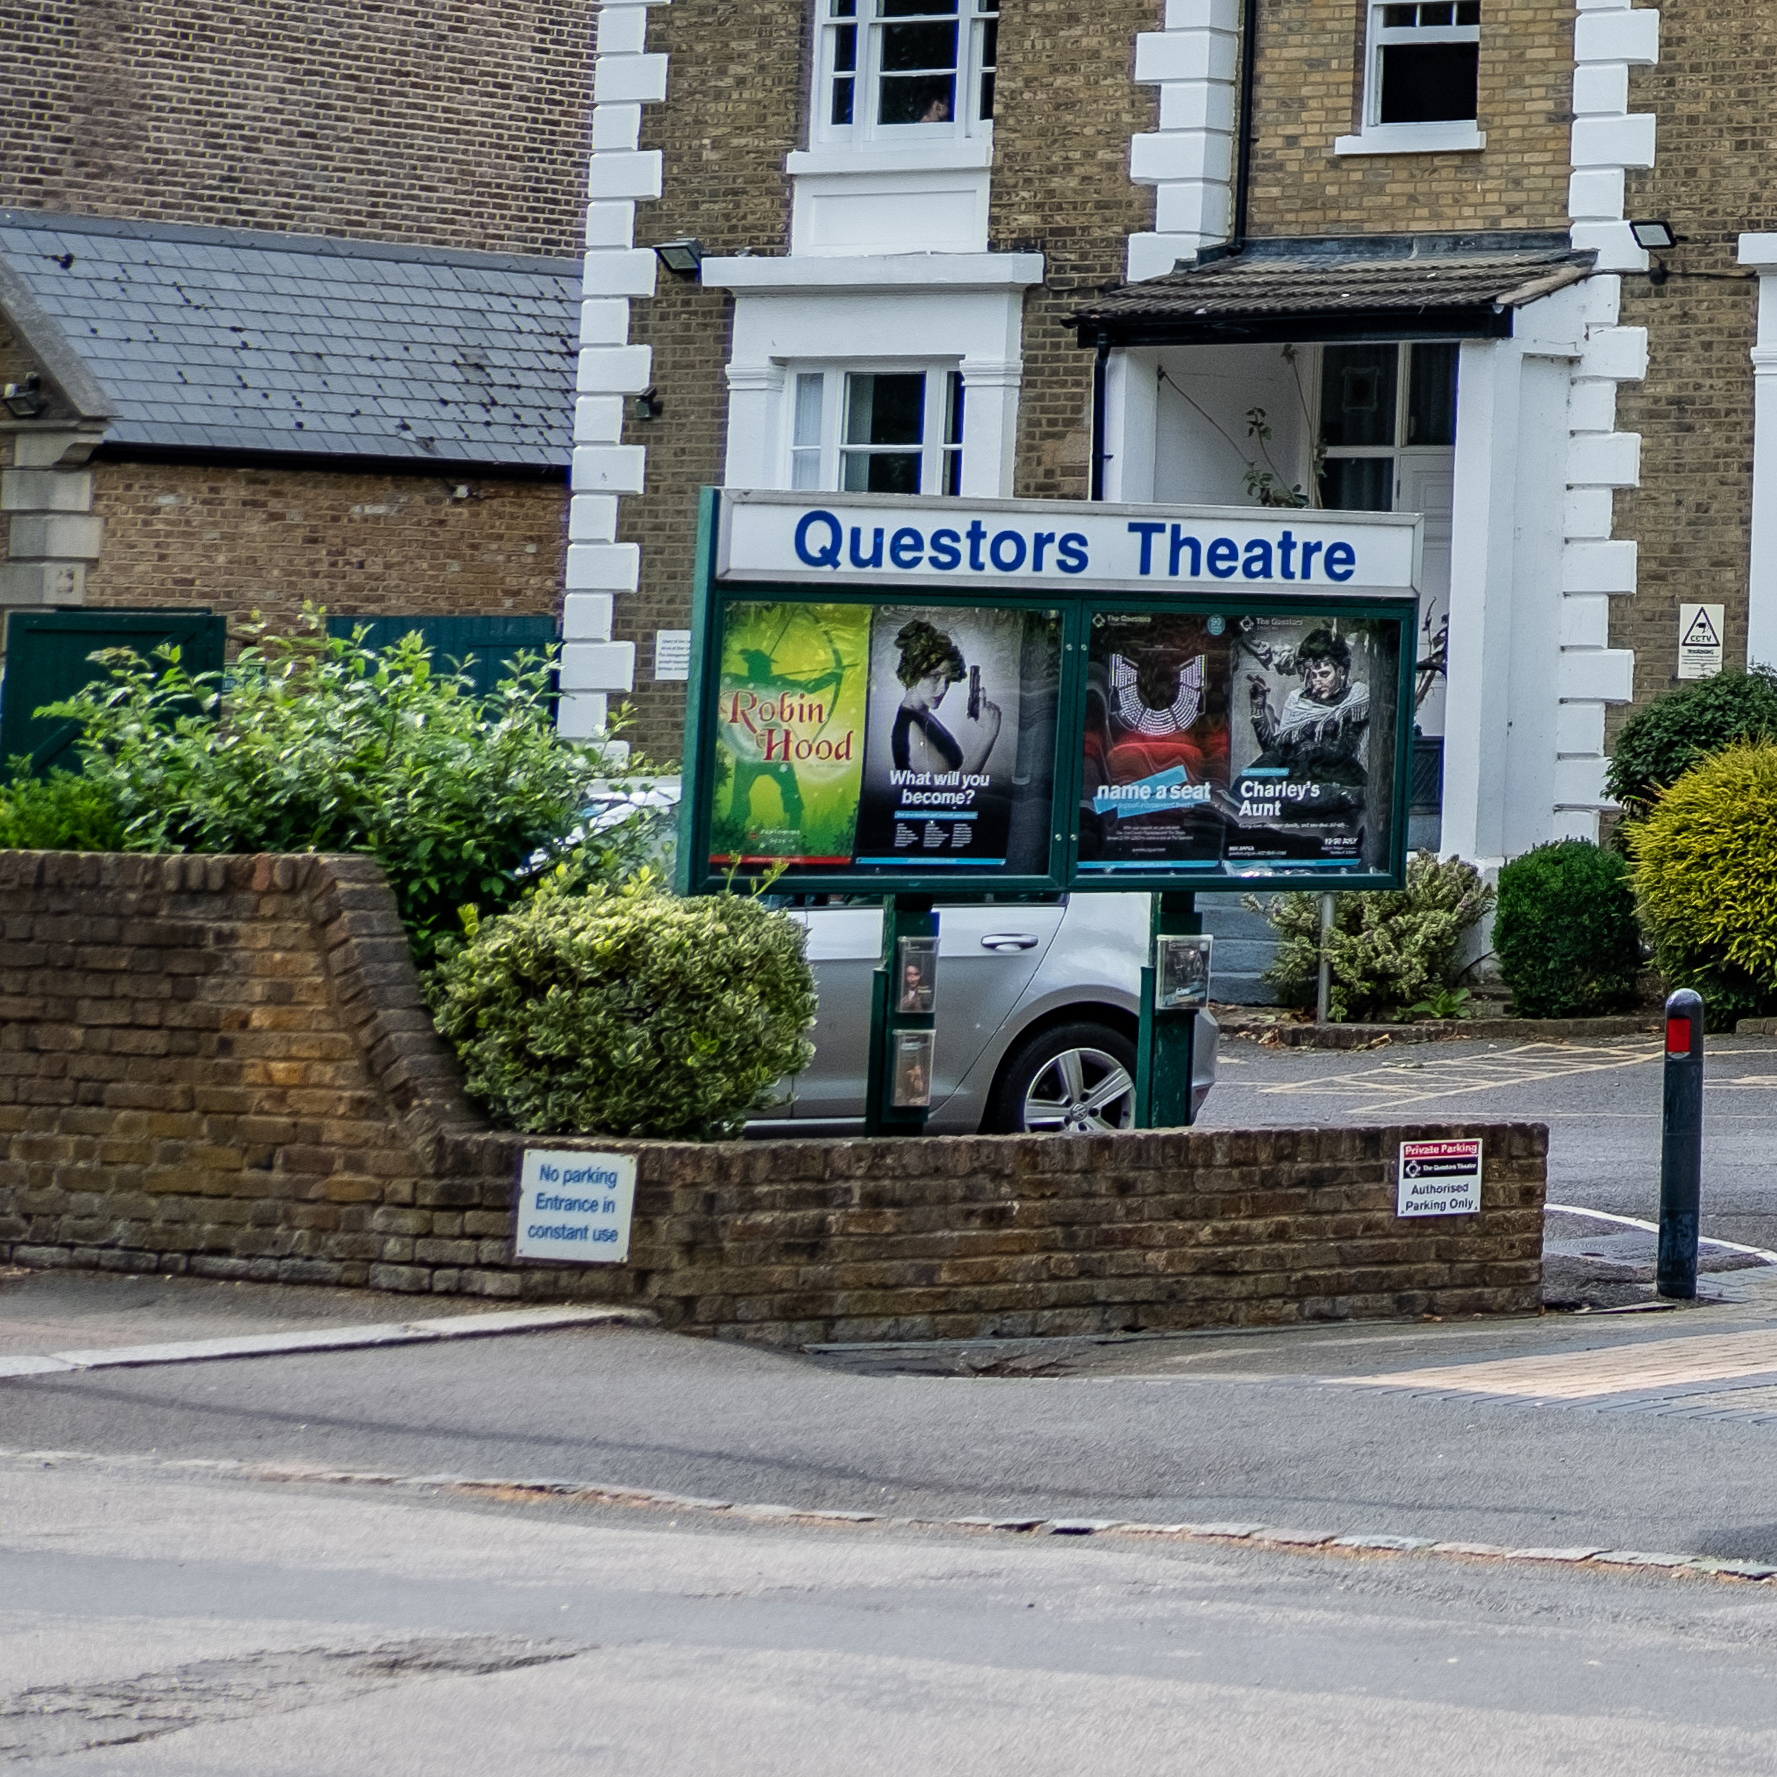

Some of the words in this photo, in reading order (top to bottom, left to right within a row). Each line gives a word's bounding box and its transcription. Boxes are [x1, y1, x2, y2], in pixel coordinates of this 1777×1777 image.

[794, 509, 1090, 573] Questors
[1127, 521, 1357, 582] Theatre
[722, 690, 827, 735] Robin
[756, 728, 854, 762] Hood
[889, 770, 931, 785] What
[933, 771, 960, 786] will
[962, 774, 990, 789] you
[901, 789, 976, 805] become?
[1096, 784, 1152, 800] name
[1155, 784, 1167, 800] a
[1169, 781, 1212, 800] seat
[1240, 780, 1321, 800] Charley's
[1239, 799, 1282, 816] Aunt
[1405, 1144, 1440, 1155] Private
[1441, 1143, 1477, 1154] Parking
[539, 1164, 560, 1182] No
[562, 1166, 618, 1189] parking
[1410, 1183, 1469, 1196] Authorised
[535, 1192, 599, 1212] Entrance
[602, 1196, 616, 1213] in
[1405, 1199, 1447, 1212] Parking
[1449, 1198, 1474, 1210] Only
[527, 1223, 590, 1241] constant
[592, 1226, 619, 1242] use
